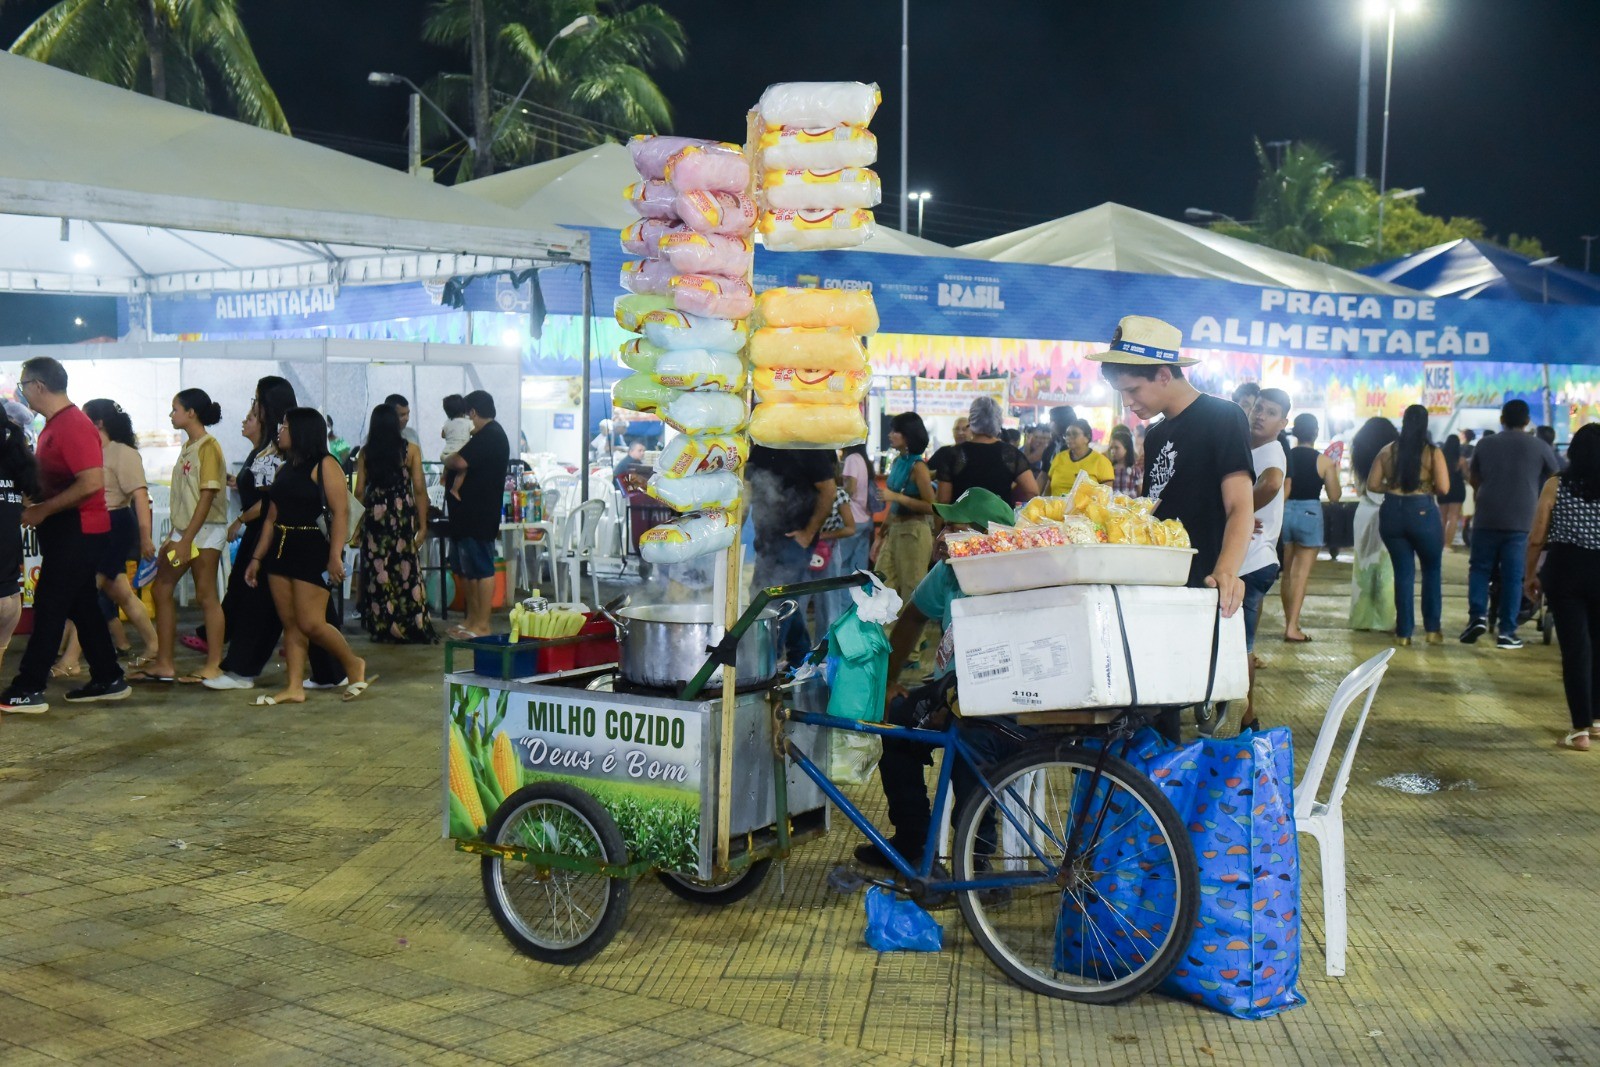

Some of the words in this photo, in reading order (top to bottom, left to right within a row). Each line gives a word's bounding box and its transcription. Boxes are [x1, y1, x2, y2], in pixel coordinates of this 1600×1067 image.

[823, 278, 873, 292] GOVERNO
[938, 282, 1005, 309] BRASIL
[1260, 289, 1382, 321] PRAÇA
[1393, 299, 1436, 321] DE
[1190, 315, 1490, 359] ALIMENTAÇÃO
[1425, 367, 1450, 389] KIBE
[9, 696, 31, 705] FILA
[1012, 690, 1039, 698] 4104
[527, 700, 596, 738] MILHO
[605, 709, 685, 749] COZIDO
[519, 736, 595, 771] "Deus
[601, 748, 618, 774] é
